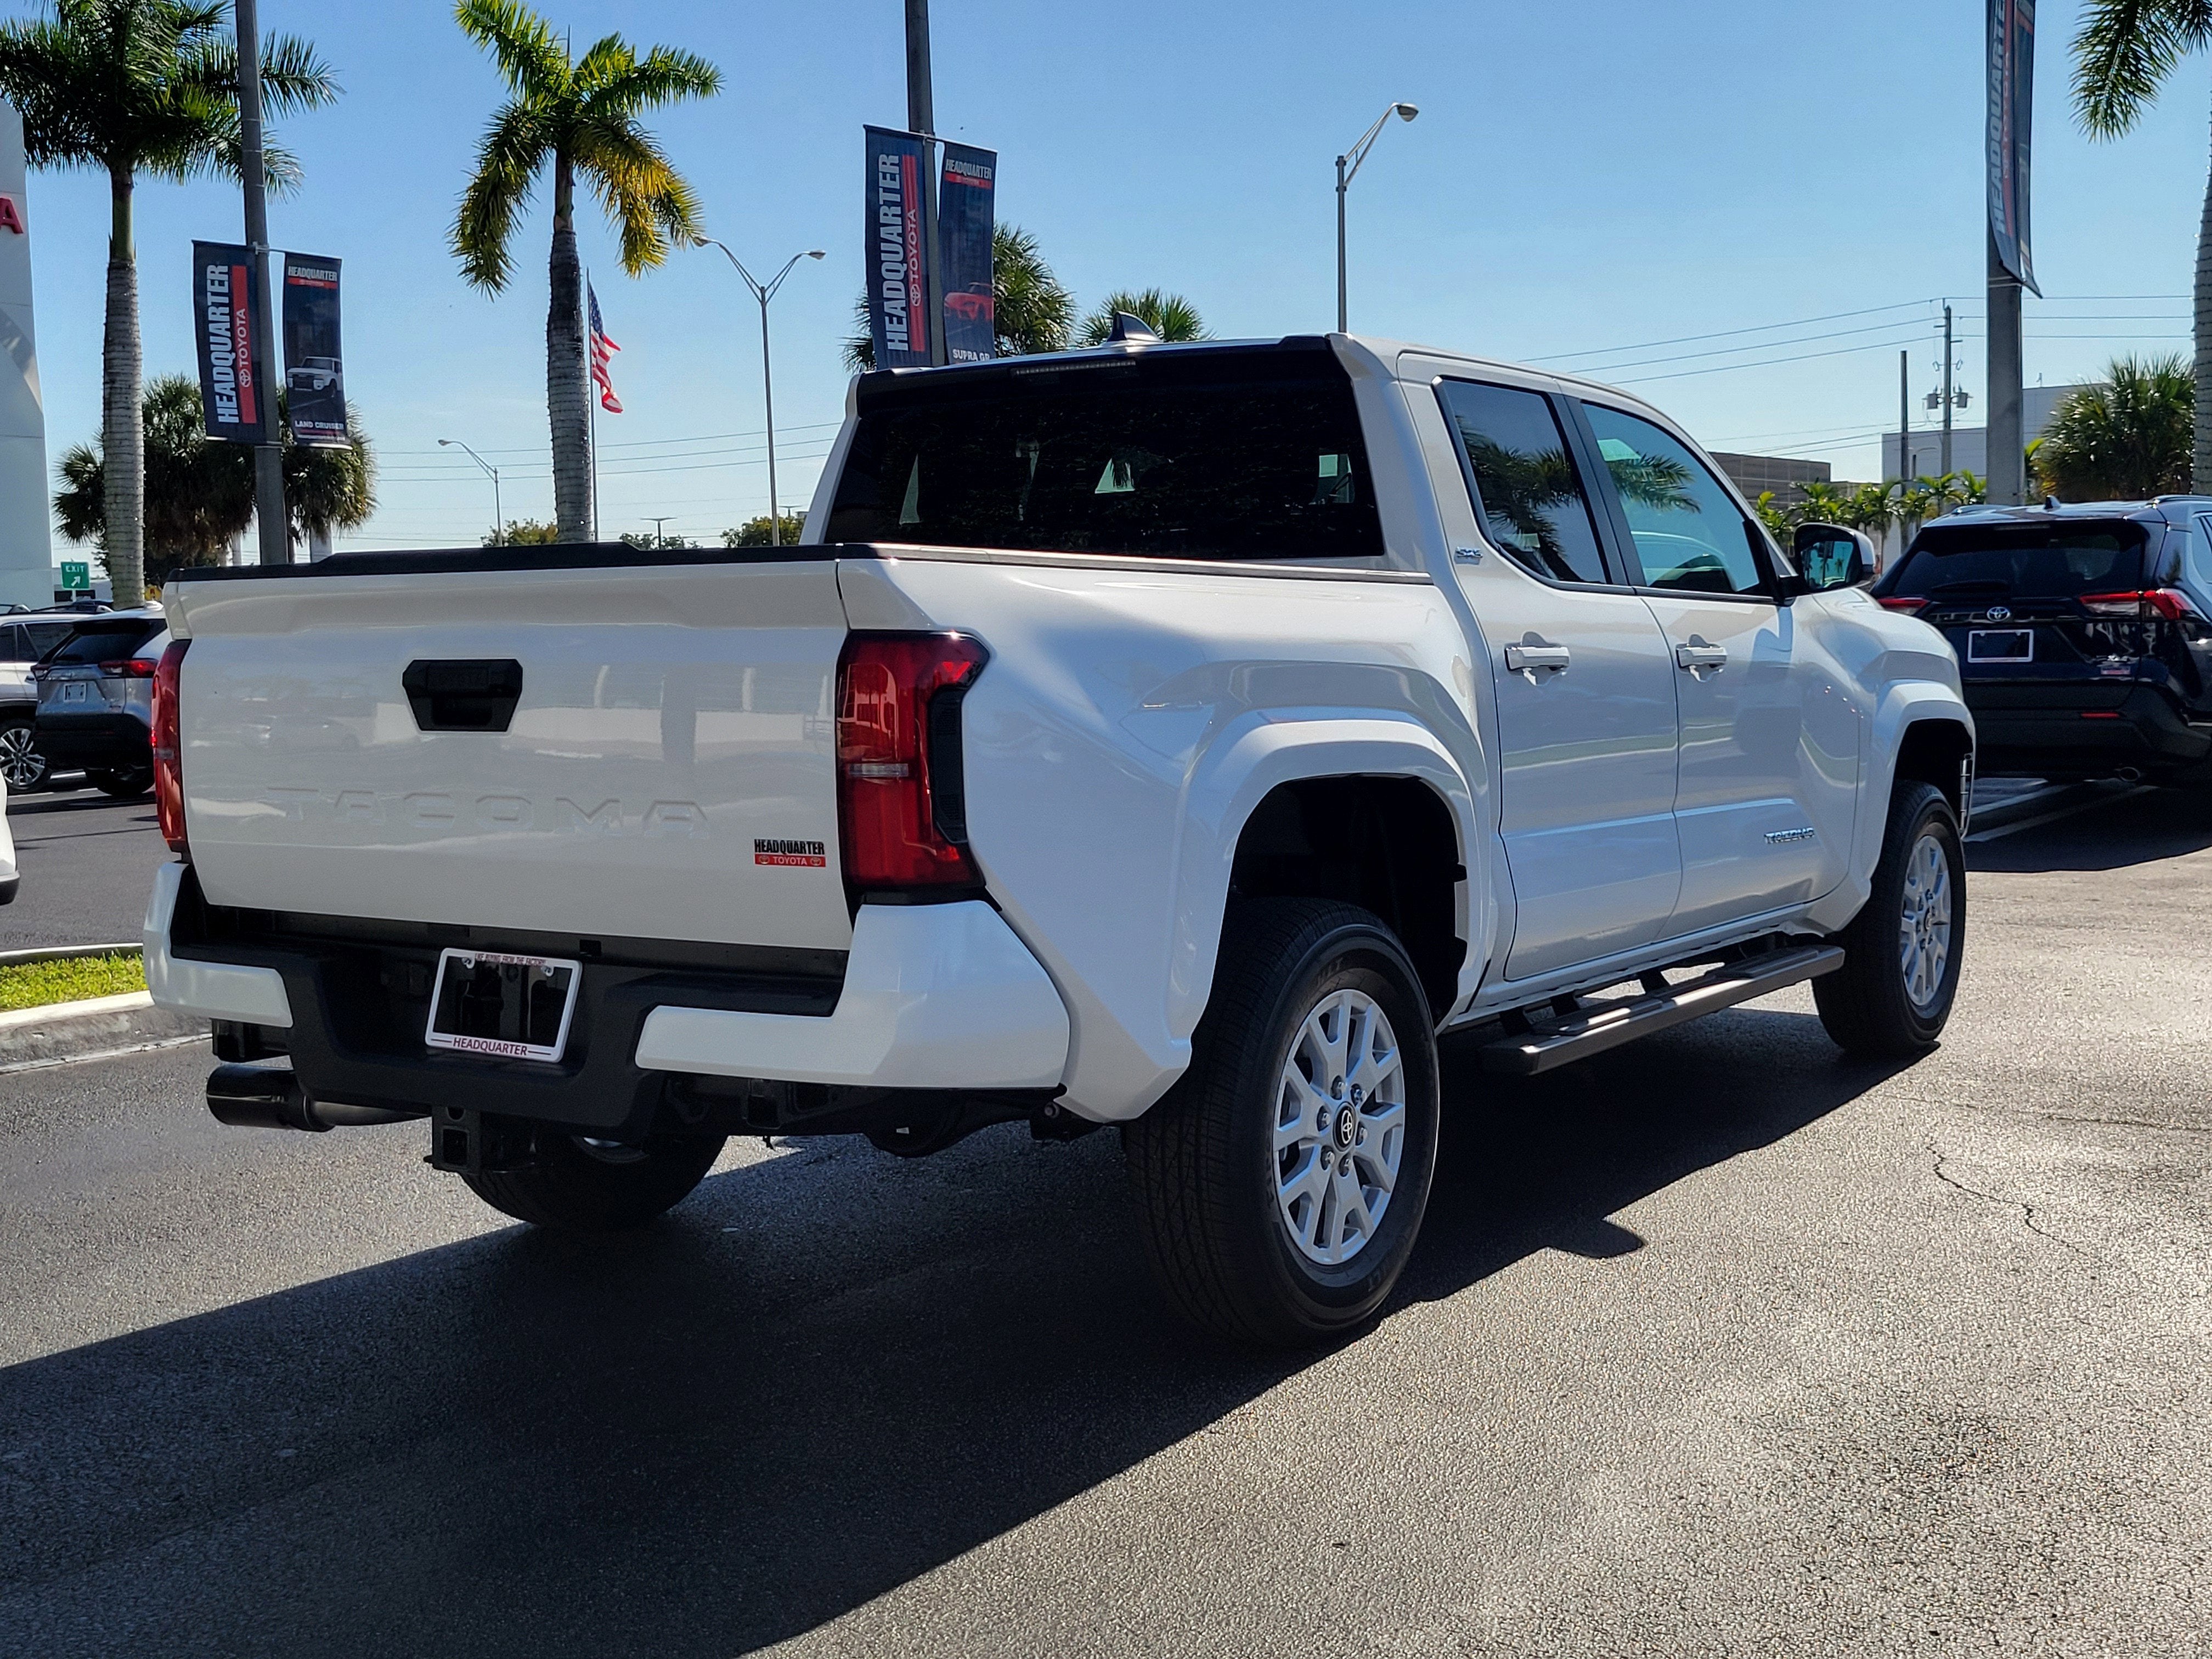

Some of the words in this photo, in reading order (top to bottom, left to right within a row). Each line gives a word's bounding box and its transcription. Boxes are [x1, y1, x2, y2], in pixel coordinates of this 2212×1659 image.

[1989, 0, 2006, 234] HEADQUARTE
[945, 159, 992, 180] HEADQUARTER
[878, 154, 908, 351] HEADQUARTER
[908, 209, 919, 279] TOYOTA
[288, 266, 337, 281] HEADQUARTER
[206, 264, 239, 423] HEADQUARTER
[236, 308, 249, 367] TOYOTA
[952, 348, 978, 362] SUPRA
[267, 787, 709, 839] TACOMA
[754, 839, 825, 855] HEADQUARTER
[772, 856, 807, 865] TOYOTA
[453, 1037, 527, 1056] HEADQUARTER
